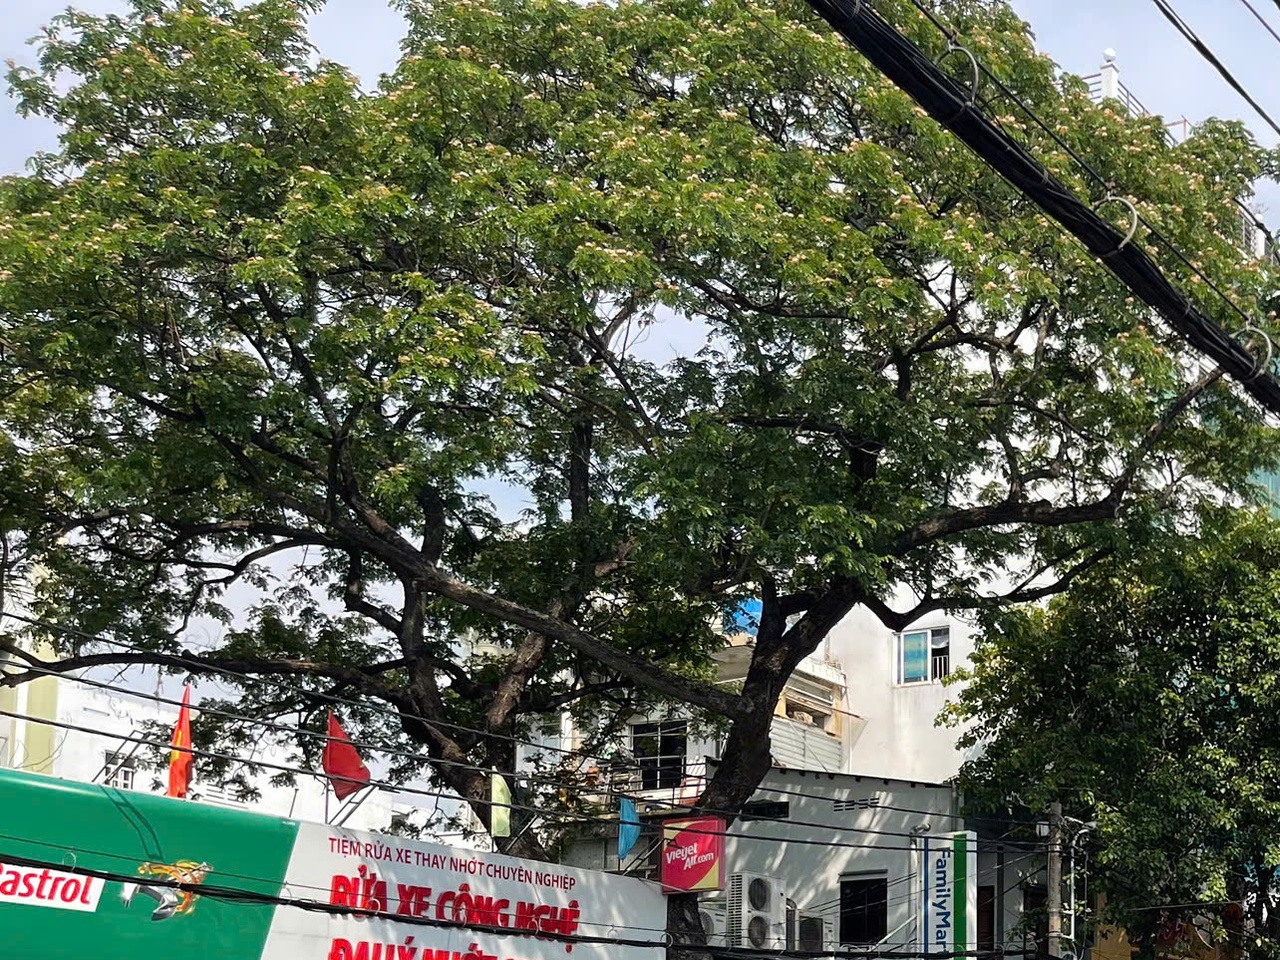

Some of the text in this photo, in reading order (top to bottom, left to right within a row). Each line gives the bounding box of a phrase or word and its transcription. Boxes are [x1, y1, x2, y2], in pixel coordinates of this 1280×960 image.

[0, 862, 91, 905] astrol
[328, 835, 576, 893] TIỆM RỬA XE THAY NHỚT CHUYÊN NGHIỆP
[397, 883, 432, 920] XE
[436, 882, 510, 928] CÔNG
[514, 900, 580, 953] NGHỆ
[932, 847, 951, 956] FamilyMar
